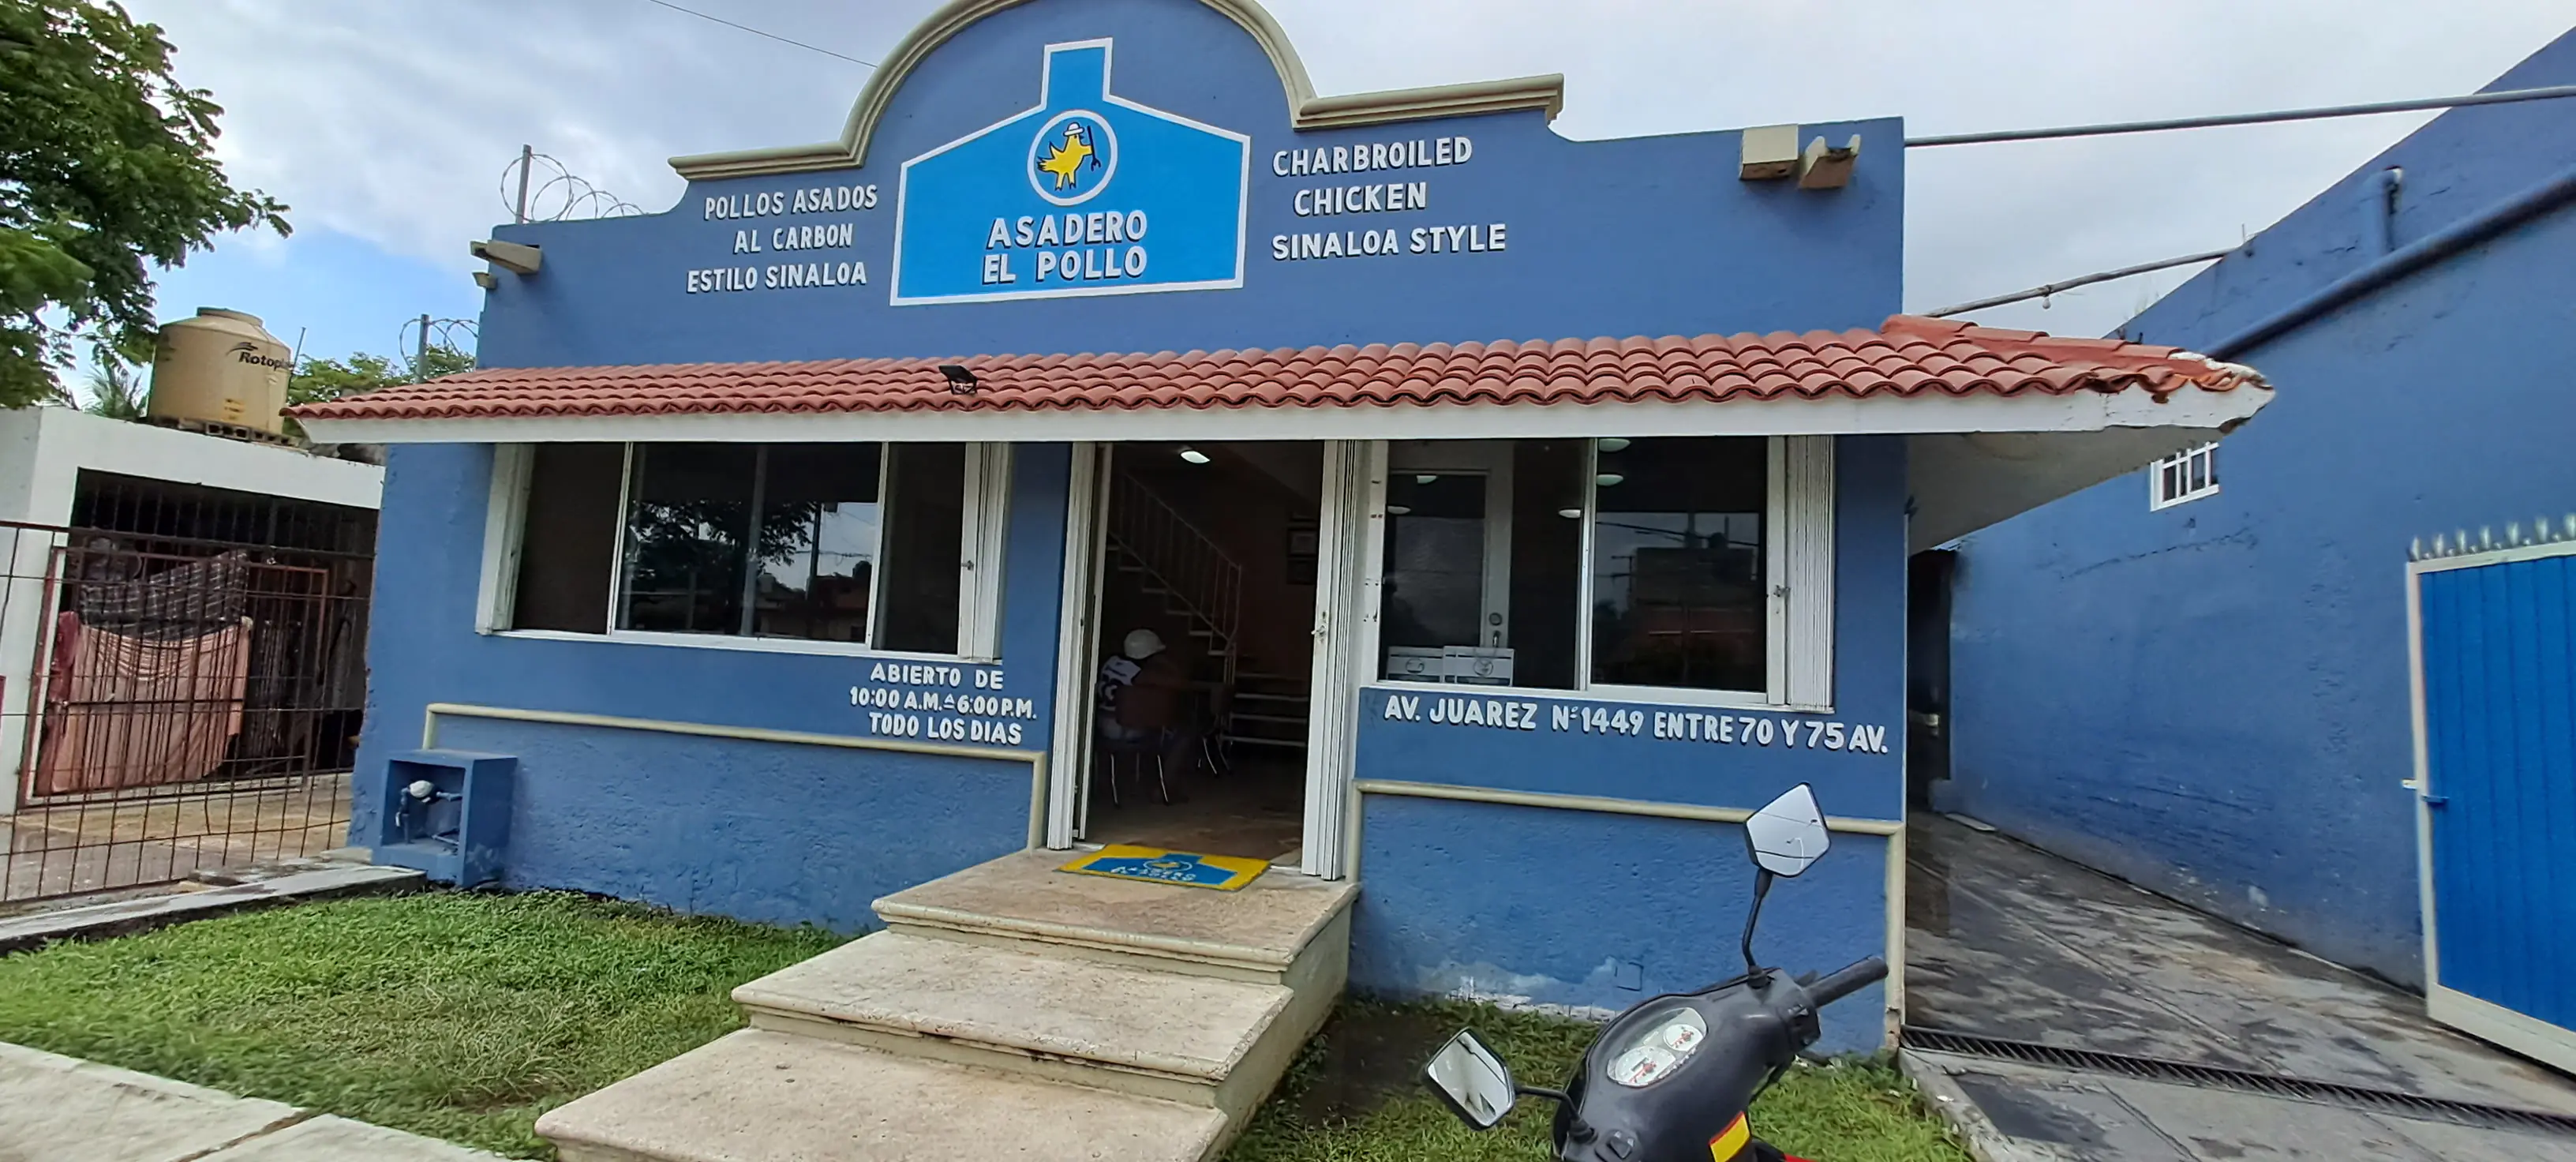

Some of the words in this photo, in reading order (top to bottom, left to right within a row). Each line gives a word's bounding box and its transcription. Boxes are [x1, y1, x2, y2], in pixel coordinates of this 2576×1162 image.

[1273, 137, 1473, 177] CHARBROILED
[704, 192, 784, 220] POLLOS
[792, 185, 878, 214] ASADOS
[1294, 182, 1427, 216] CHICKEN
[733, 229, 762, 254] AL
[772, 223, 853, 251] CARBON
[987, 210, 1148, 249] ASADERO
[1272, 229, 1398, 261] SINALOA
[1409, 223, 1506, 253] STYLE
[687, 267, 758, 294] ESTILO
[765, 261, 867, 289] SINALOA
[982, 253, 1017, 285] EL
[1035, 246, 1148, 282] POLLO
[870, 662, 961, 688] ABIERTO
[975, 669, 1004, 690] DE
[850, 686, 900, 709] 10:00
[869, 712, 919, 737] TODO
[927, 717, 965, 740] LOS
[970, 719, 1022, 745] DIAS
[1384, 695, 1421, 722] AV.
[1428, 698, 1537, 730] JUAREZ
[1653, 711, 1733, 744] ENTRE
[1738, 716, 1774, 746] 70
[1780, 718, 1799, 747] Y
[1805, 721, 1845, 749] 75
[1848, 725, 1889, 754] AV.
